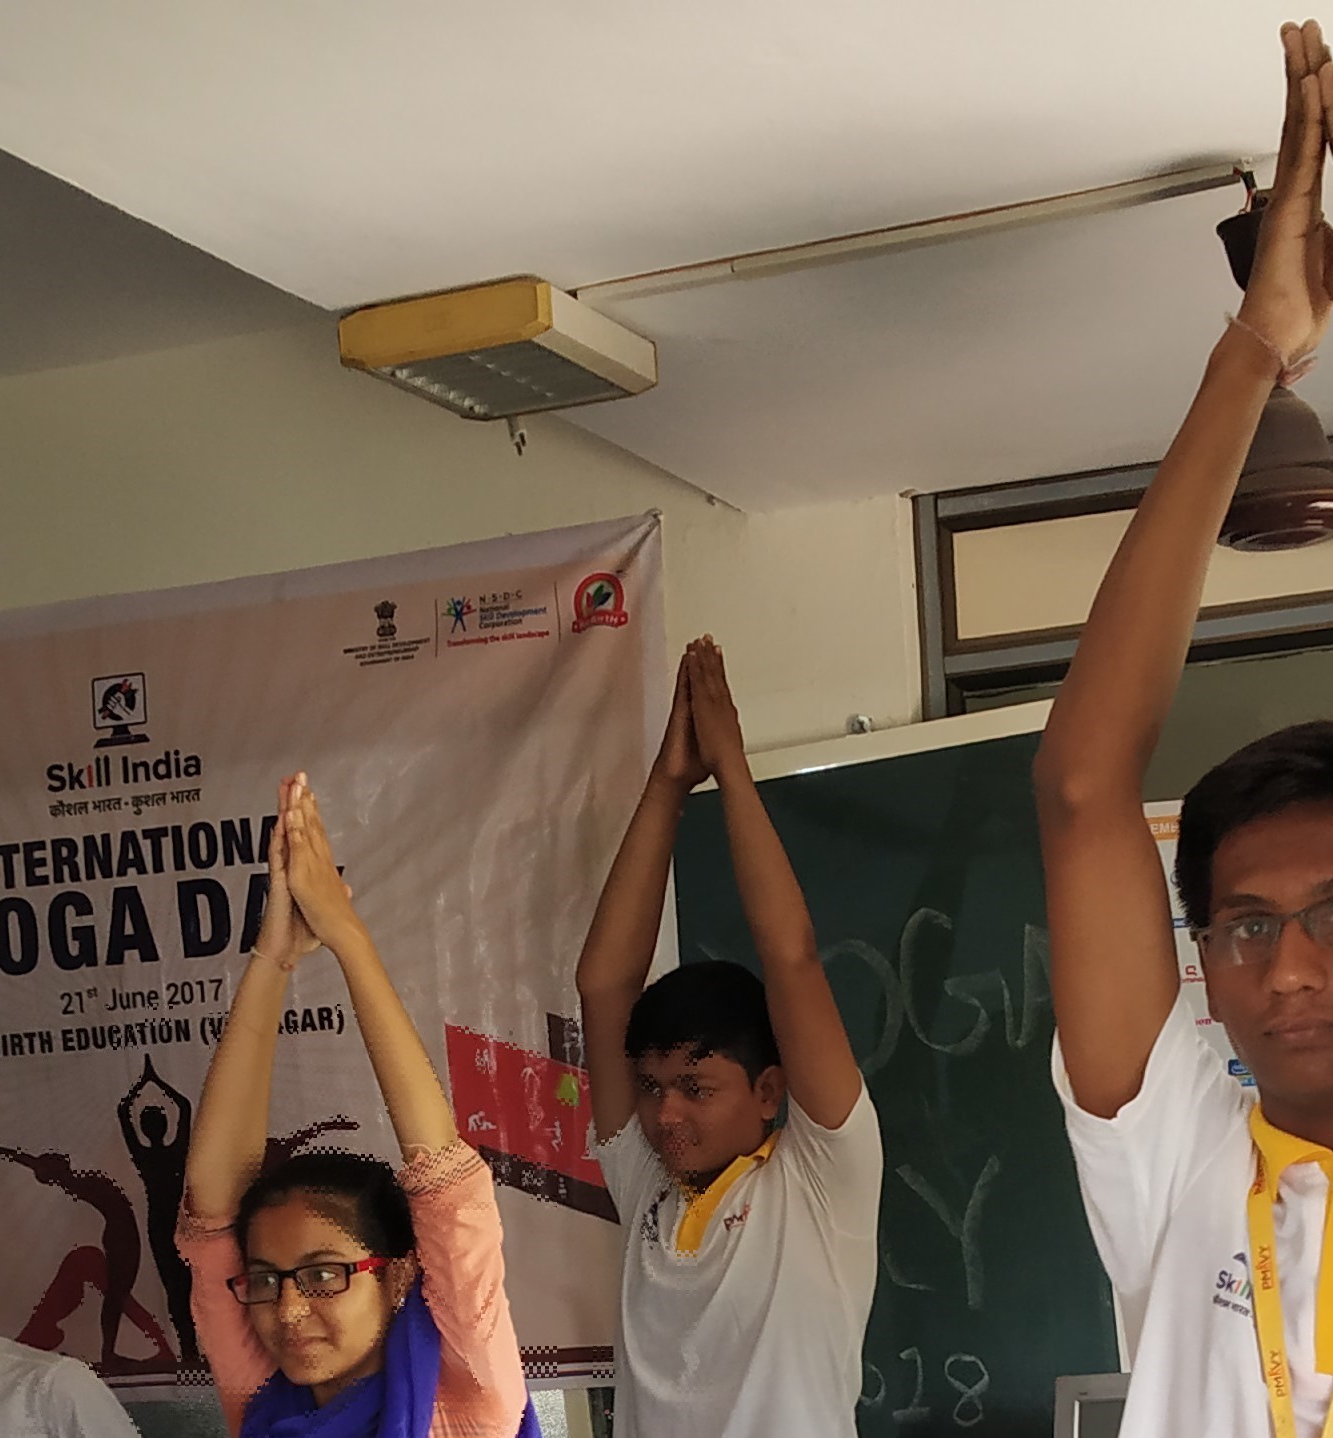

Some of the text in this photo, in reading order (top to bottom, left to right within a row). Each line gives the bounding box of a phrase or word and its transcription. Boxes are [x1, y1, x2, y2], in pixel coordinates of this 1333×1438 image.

[46, 750, 202, 792] Skill India
[170, 788, 202, 804] भारत
[106, 986, 159, 1012] June
[166, 978, 224, 1006] 2017
[62, 1018, 190, 1050] EDUCATION
